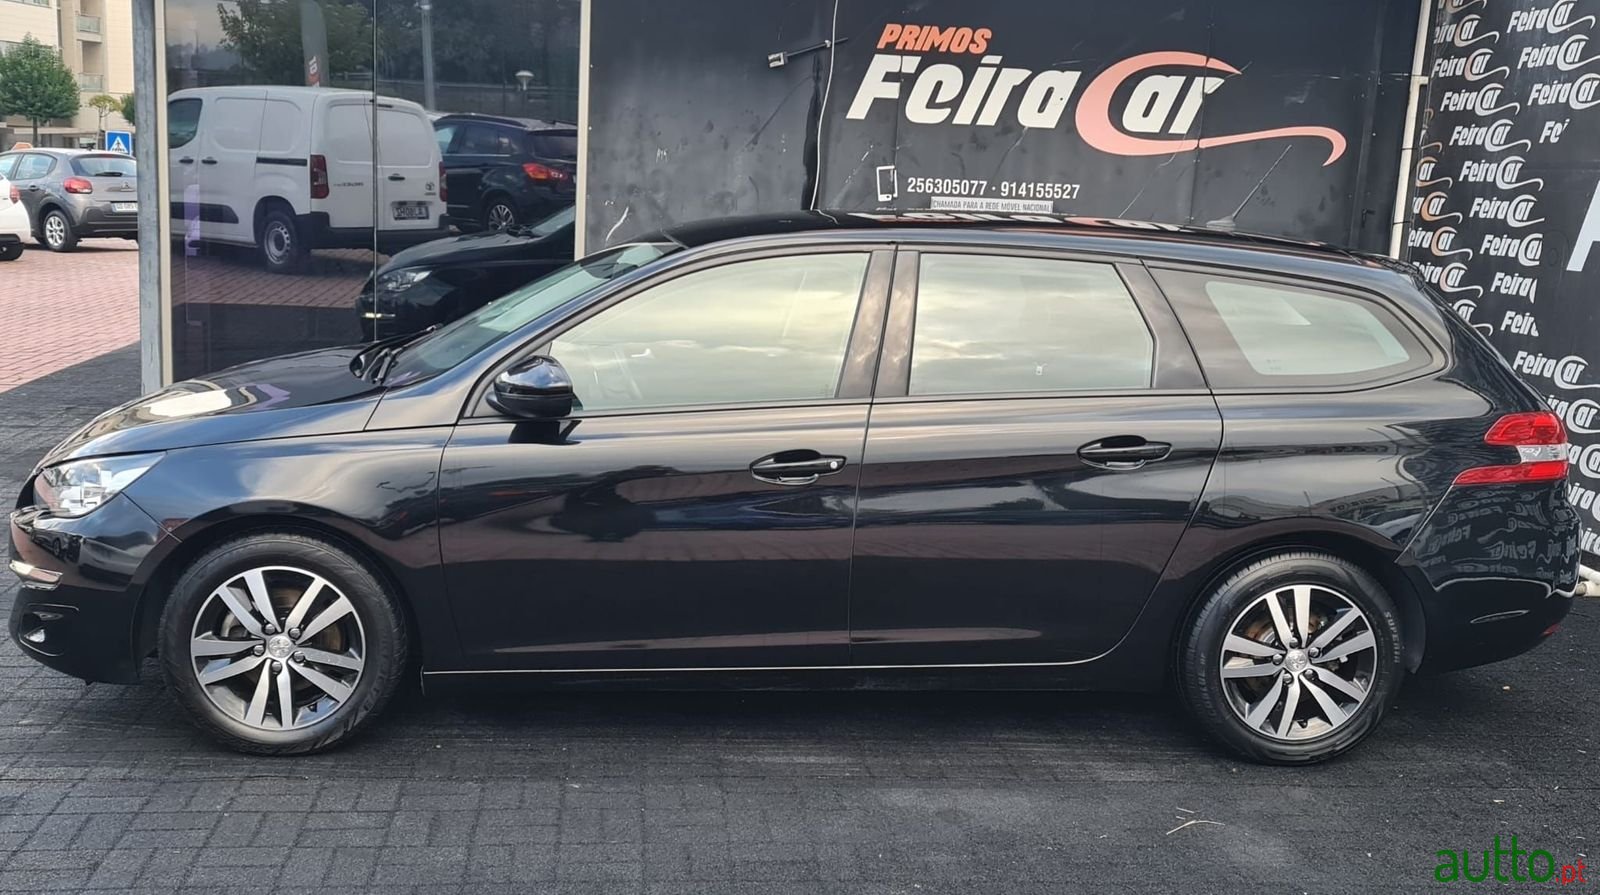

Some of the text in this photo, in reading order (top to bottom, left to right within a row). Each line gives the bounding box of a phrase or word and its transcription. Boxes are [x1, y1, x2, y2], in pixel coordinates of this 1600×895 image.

[876, 23, 992, 54] PRIMOS
[1517, 34, 1589, 71] FeiraCar
[1431, 48, 1494, 81] FeiraCar
[1440, 83, 1504, 116] FeiraCar
[1449, 119, 1514, 152] FeiraCar
[907, 177, 1080, 199] 256305077 914155527
[1458, 155, 1526, 189] FeiraCar
[963, 201, 978, 209] PARA
[985, 202, 1000, 210] REDE
[1469, 194, 1538, 227] FeiraCar
[1513, 350, 1589, 390] FeiraCar
